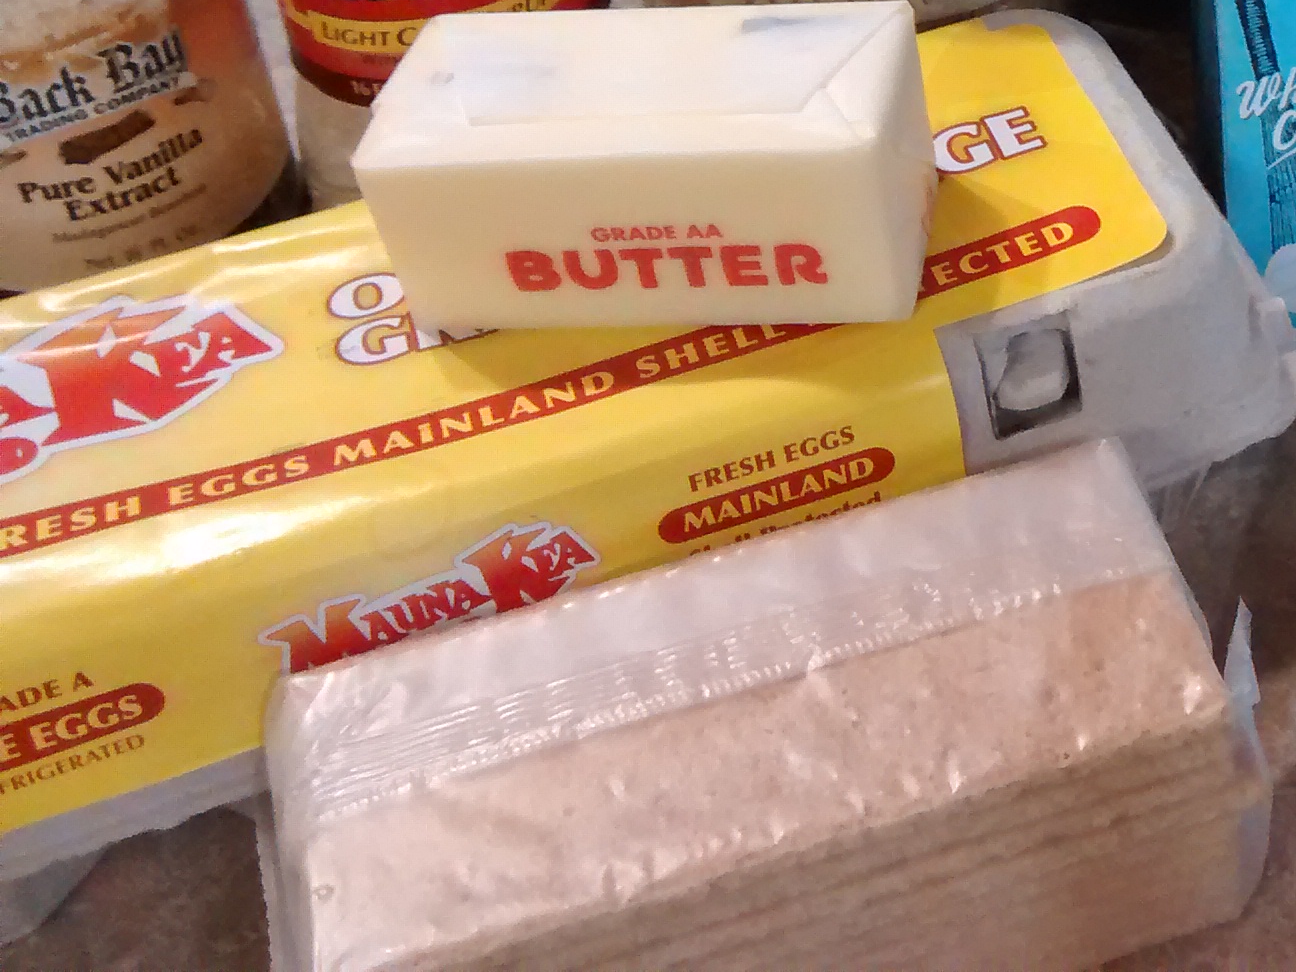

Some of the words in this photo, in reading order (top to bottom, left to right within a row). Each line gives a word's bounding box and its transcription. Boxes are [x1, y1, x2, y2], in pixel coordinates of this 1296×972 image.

[321, 21, 389, 46] LIGHT
[17, 176, 96, 204] Pure
[102, 128, 204, 186] Vanilla
[63, 165, 180, 221] Extract
[590, 225, 677, 242] GRADE
[685, 223, 724, 239] AA
[504, 243, 829, 292] BUTTER
[168, 455, 310, 506] EGGS
[333, 370, 615, 467] MAINLAND
[635, 326, 790, 380] SHELL
[687, 449, 776, 492] FRESH
[782, 425, 855, 463] EGGS
[683, 456, 875, 533] MAINLAND
[72, 670, 95, 692] A
[29, 694, 144, 751] EGGS
